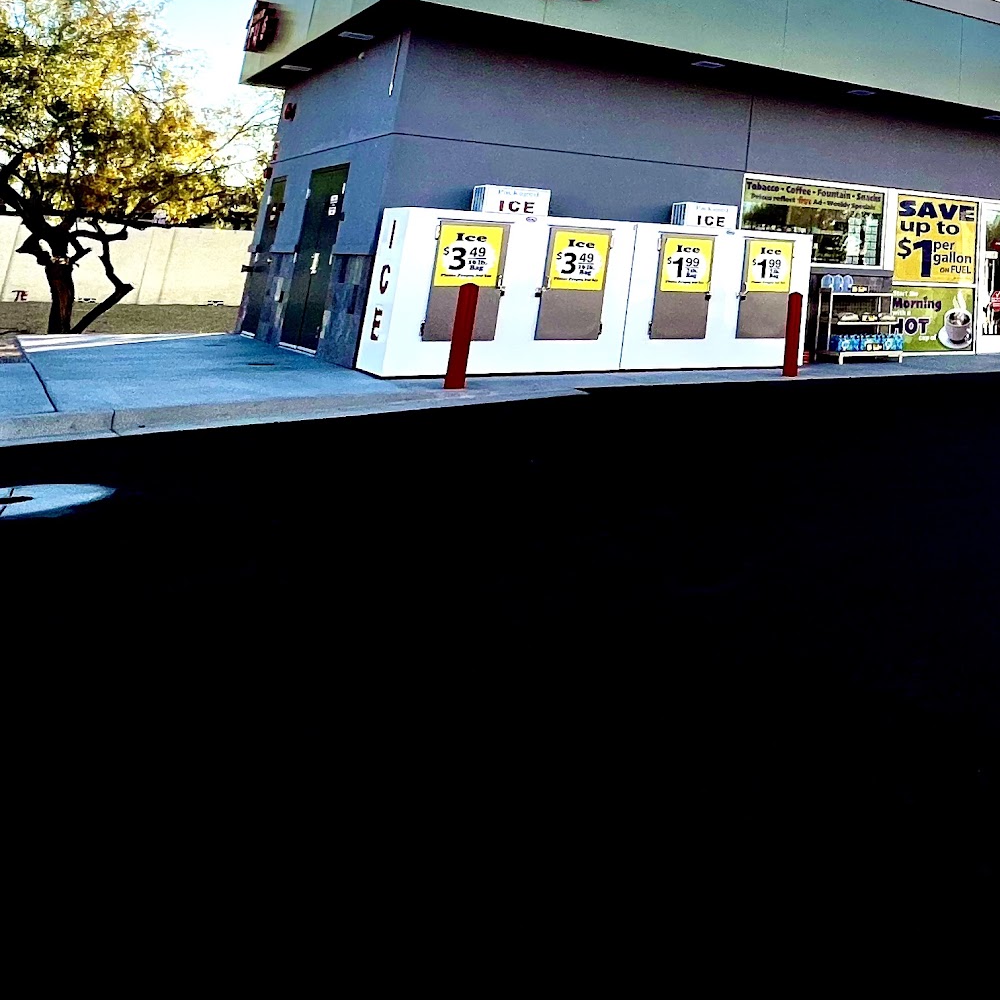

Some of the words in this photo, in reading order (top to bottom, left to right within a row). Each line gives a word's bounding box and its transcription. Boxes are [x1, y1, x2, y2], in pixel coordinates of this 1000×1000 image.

[746, 181, 780, 193] Tobacco
[786, 185, 812, 196] Coffee
[817, 189, 851, 200] Fountain
[856, 193, 881, 203] Snacks
[499, 200, 535, 214] ICE
[898, 200, 975, 222] SAVE
[697, 215, 726, 227] ICE
[900, 221, 931, 237] up
[937, 221, 960, 235] to
[456, 232, 488, 242] Ice
[568, 239, 595, 249] Ice
[676, 244, 700, 253] Ice
[933, 241, 956, 252] per
[760, 247, 782, 255] Ice
[933, 252, 972, 265] gallon
[950, 265, 973, 274] FUEL
[893, 296, 942, 312] Morning
